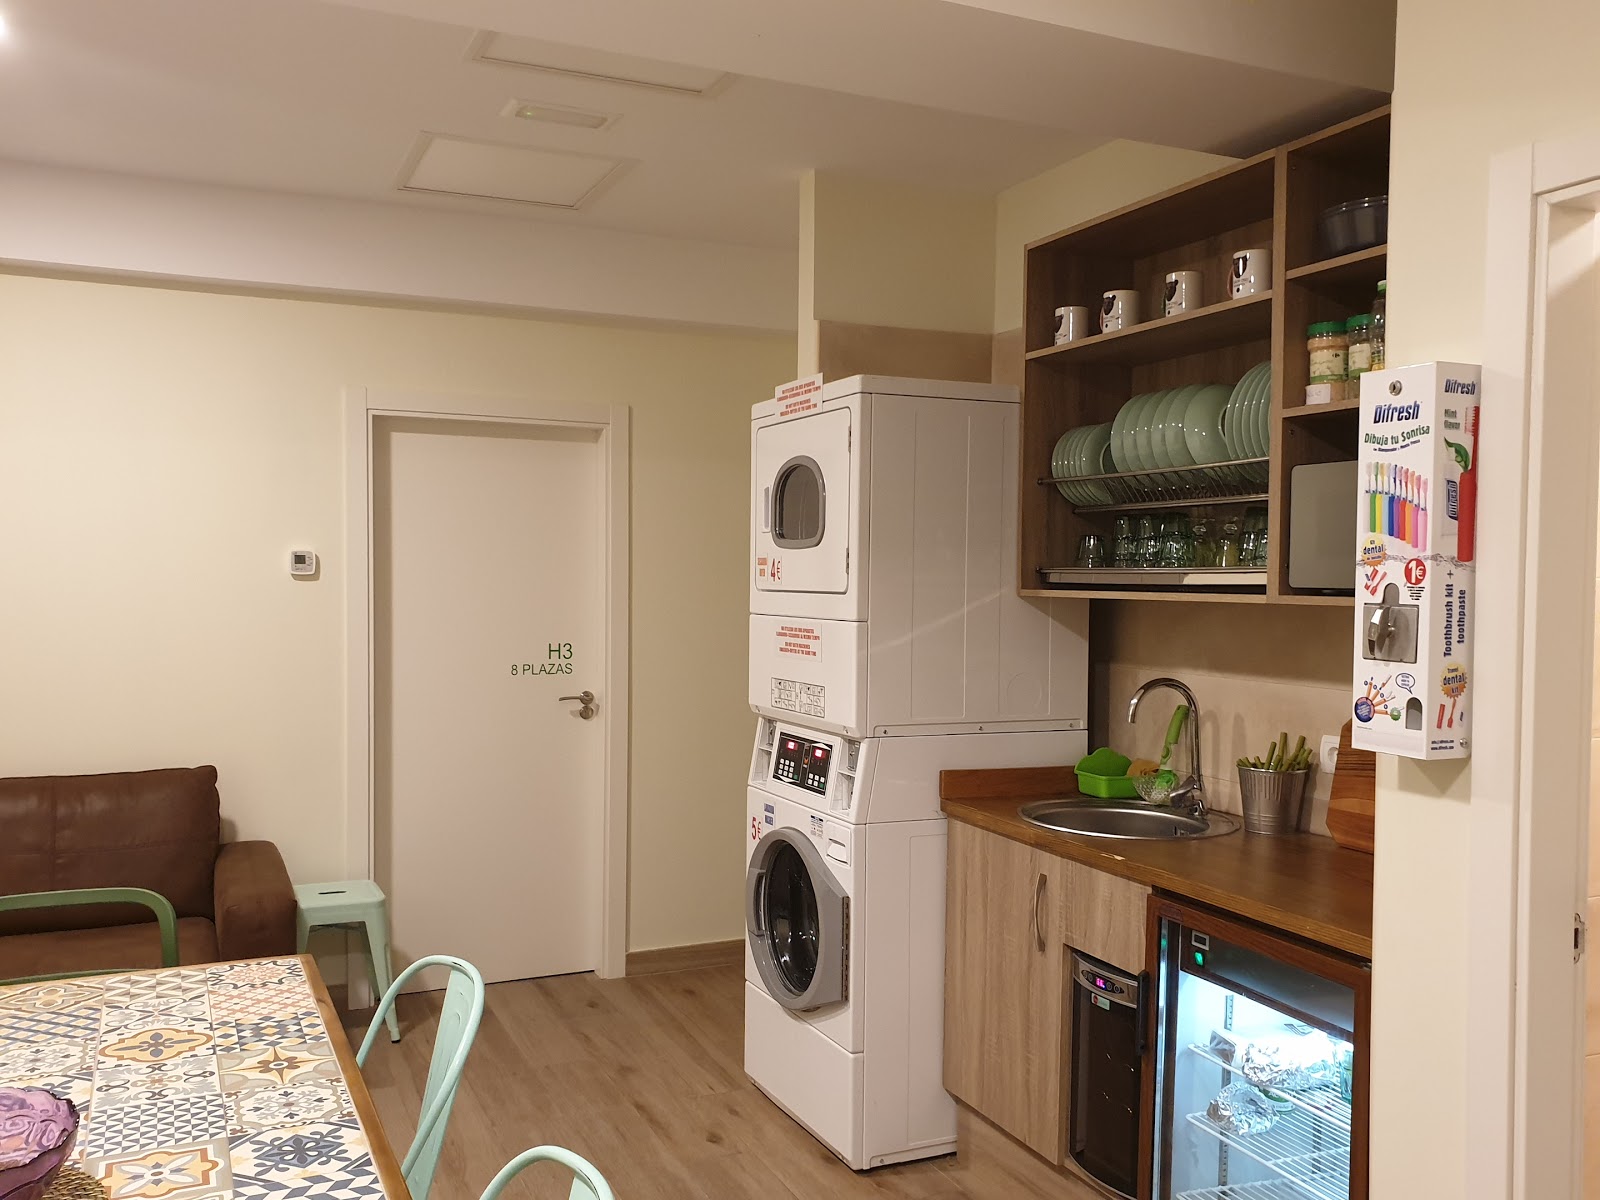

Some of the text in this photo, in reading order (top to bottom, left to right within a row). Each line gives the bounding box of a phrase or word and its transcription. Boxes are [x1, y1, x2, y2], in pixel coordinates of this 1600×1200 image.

[1444, 379, 1476, 395] Difresh
[1373, 400, 1420, 424] Difresh
[1364, 433, 1389, 446] Dibuja
[1391, 435, 1399, 445] tu
[1400, 424, 1430, 442] Sonrisa
[1363, 543, 1384, 555] dental
[771, 558, 781, 582] 4€
[1408, 560, 1424, 584] 1€
[1445, 583, 1454, 598] kit
[1456, 589, 1466, 644] toothpaste
[1443, 600, 1453, 658] Toothbrush
[548, 642, 573, 660] H3
[511, 662, 573, 676] 8 PLAZAS
[1443, 673, 1465, 685] dental
[752, 816, 762, 840] 5€
